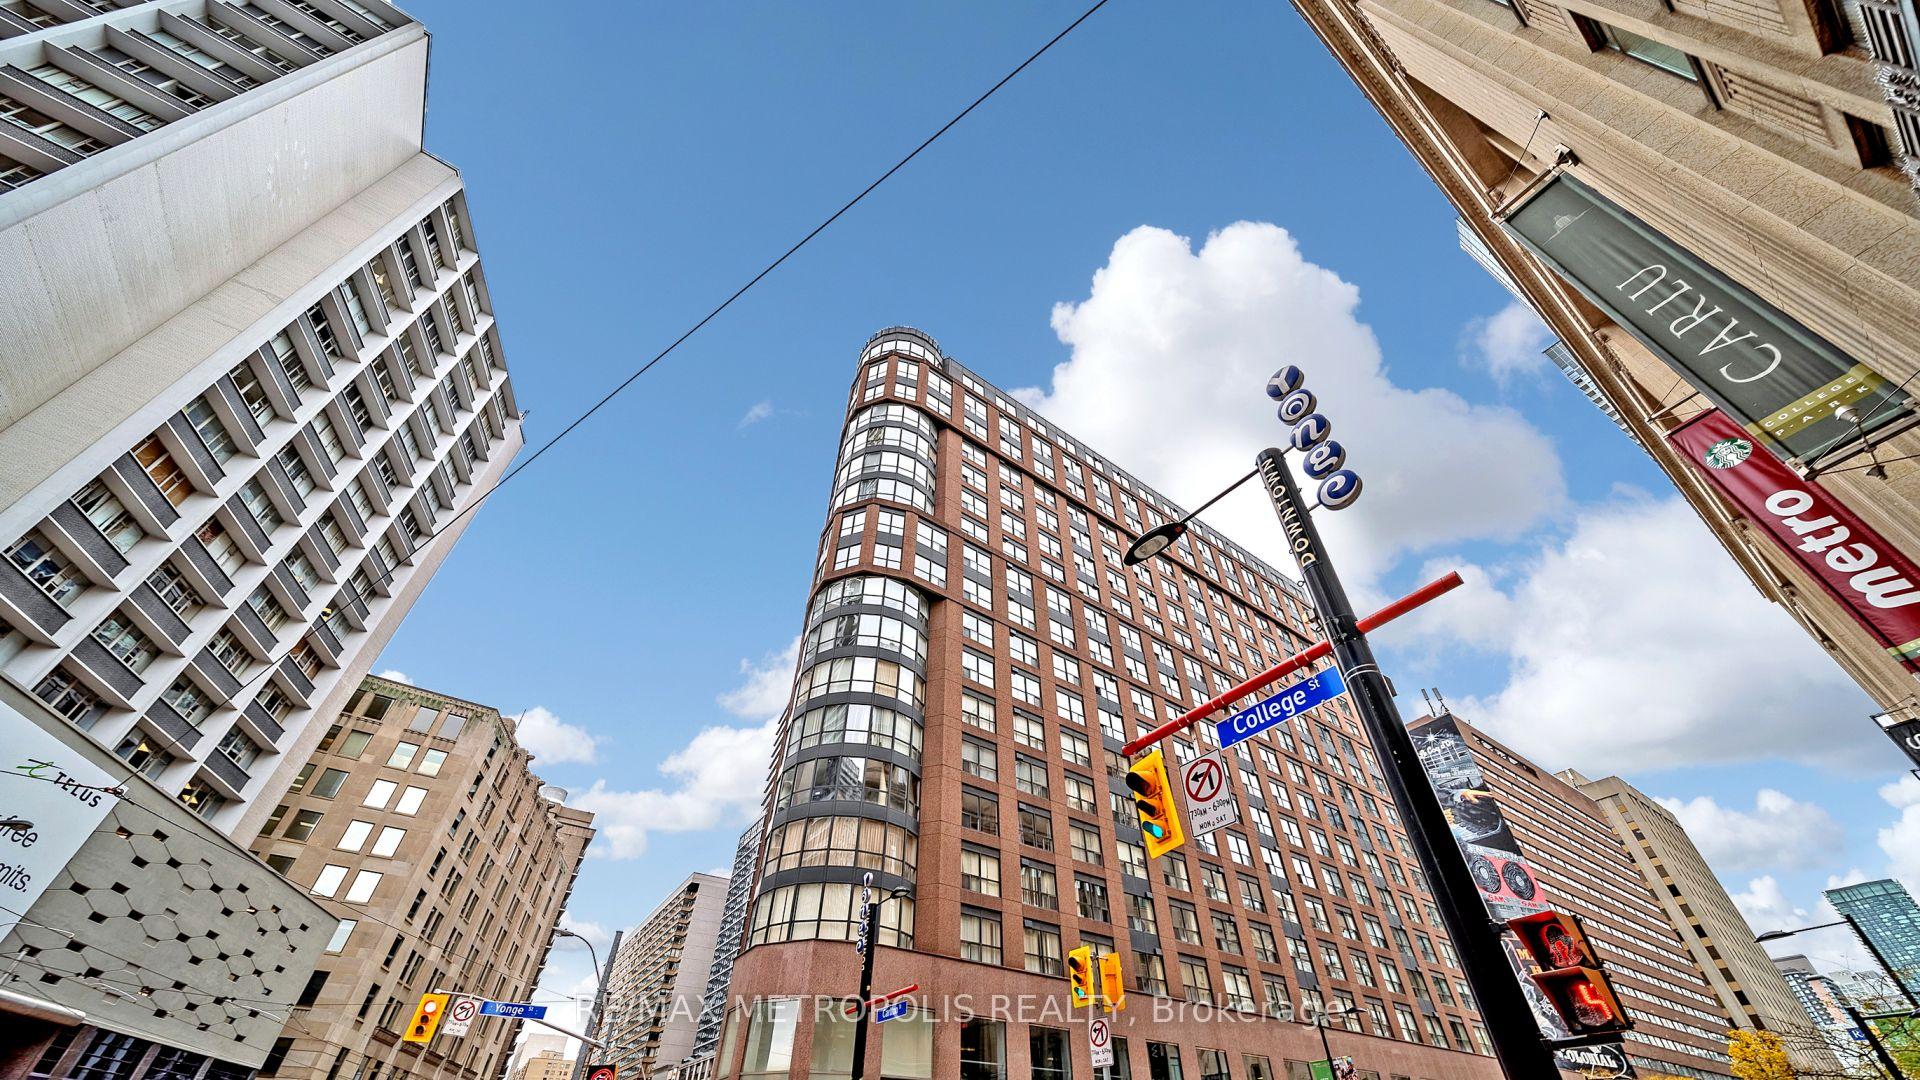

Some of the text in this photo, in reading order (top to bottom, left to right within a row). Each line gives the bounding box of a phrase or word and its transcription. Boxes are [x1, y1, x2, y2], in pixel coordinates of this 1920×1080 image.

[1615, 264, 1783, 384] CARLU
[1764, 376, 1857, 428] COLLEGE
[1267, 365, 1360, 508] Yonge
[1260, 456, 1317, 567] DOWNTOWN
[1765, 489, 1920, 609] metro
[1232, 678, 1321, 735] College St
[54, 771, 102, 808] TELUS
[1215, 813, 1227, 824] SAT
[495, 1003, 524, 1016] Yonge
